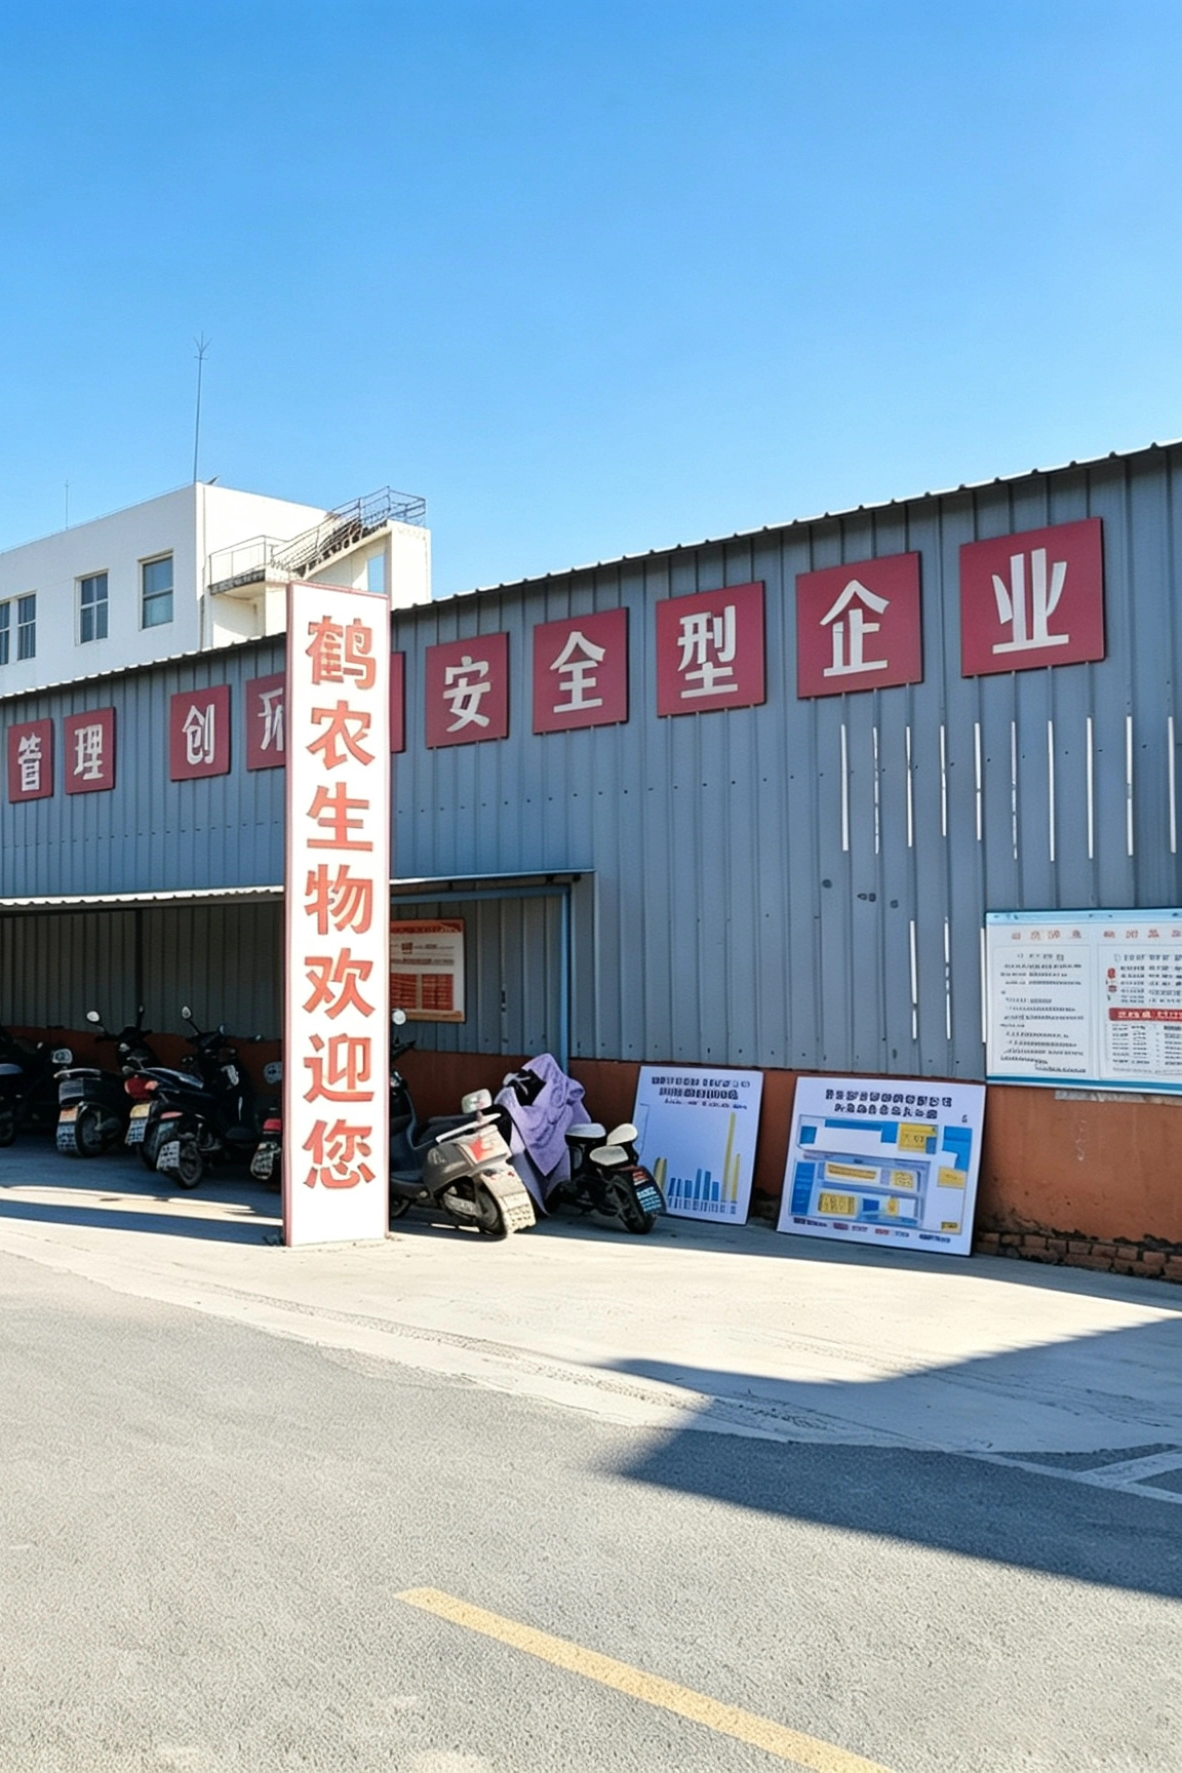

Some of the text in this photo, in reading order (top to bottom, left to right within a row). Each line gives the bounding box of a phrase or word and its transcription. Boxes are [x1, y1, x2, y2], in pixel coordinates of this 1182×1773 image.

[302, 615, 376, 1190] 鹤农生物欢迎您
